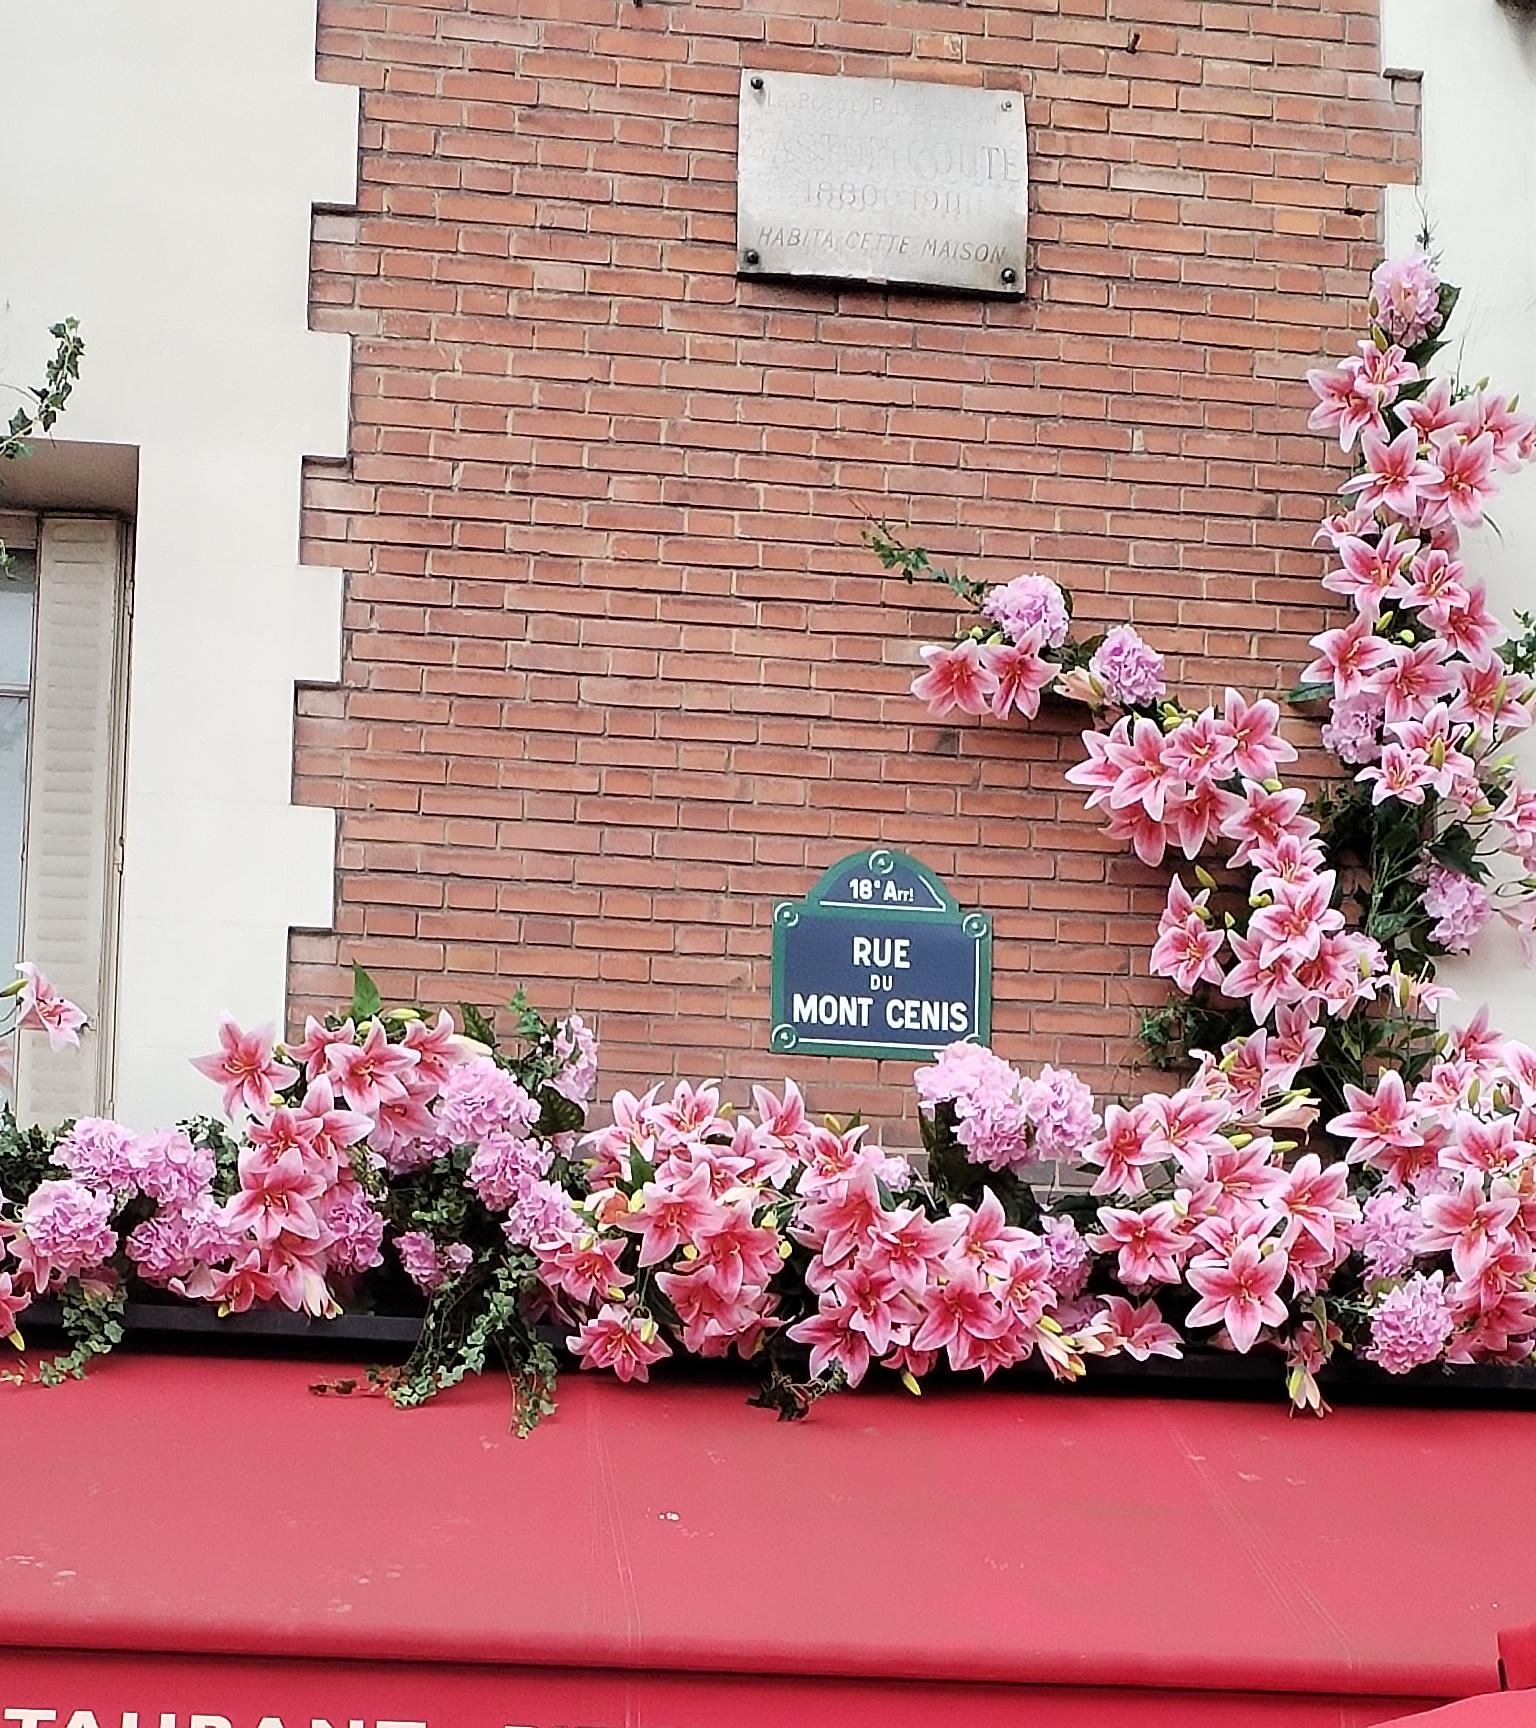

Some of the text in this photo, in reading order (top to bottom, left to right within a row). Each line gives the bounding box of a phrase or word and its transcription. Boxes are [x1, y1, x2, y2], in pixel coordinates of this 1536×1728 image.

[757, 226, 1008, 265] HABITA CETTE MAISON
[853, 936, 912, 969] RUE
[870, 974, 894, 991] DU
[792, 993, 969, 1032] MONT CENIS
